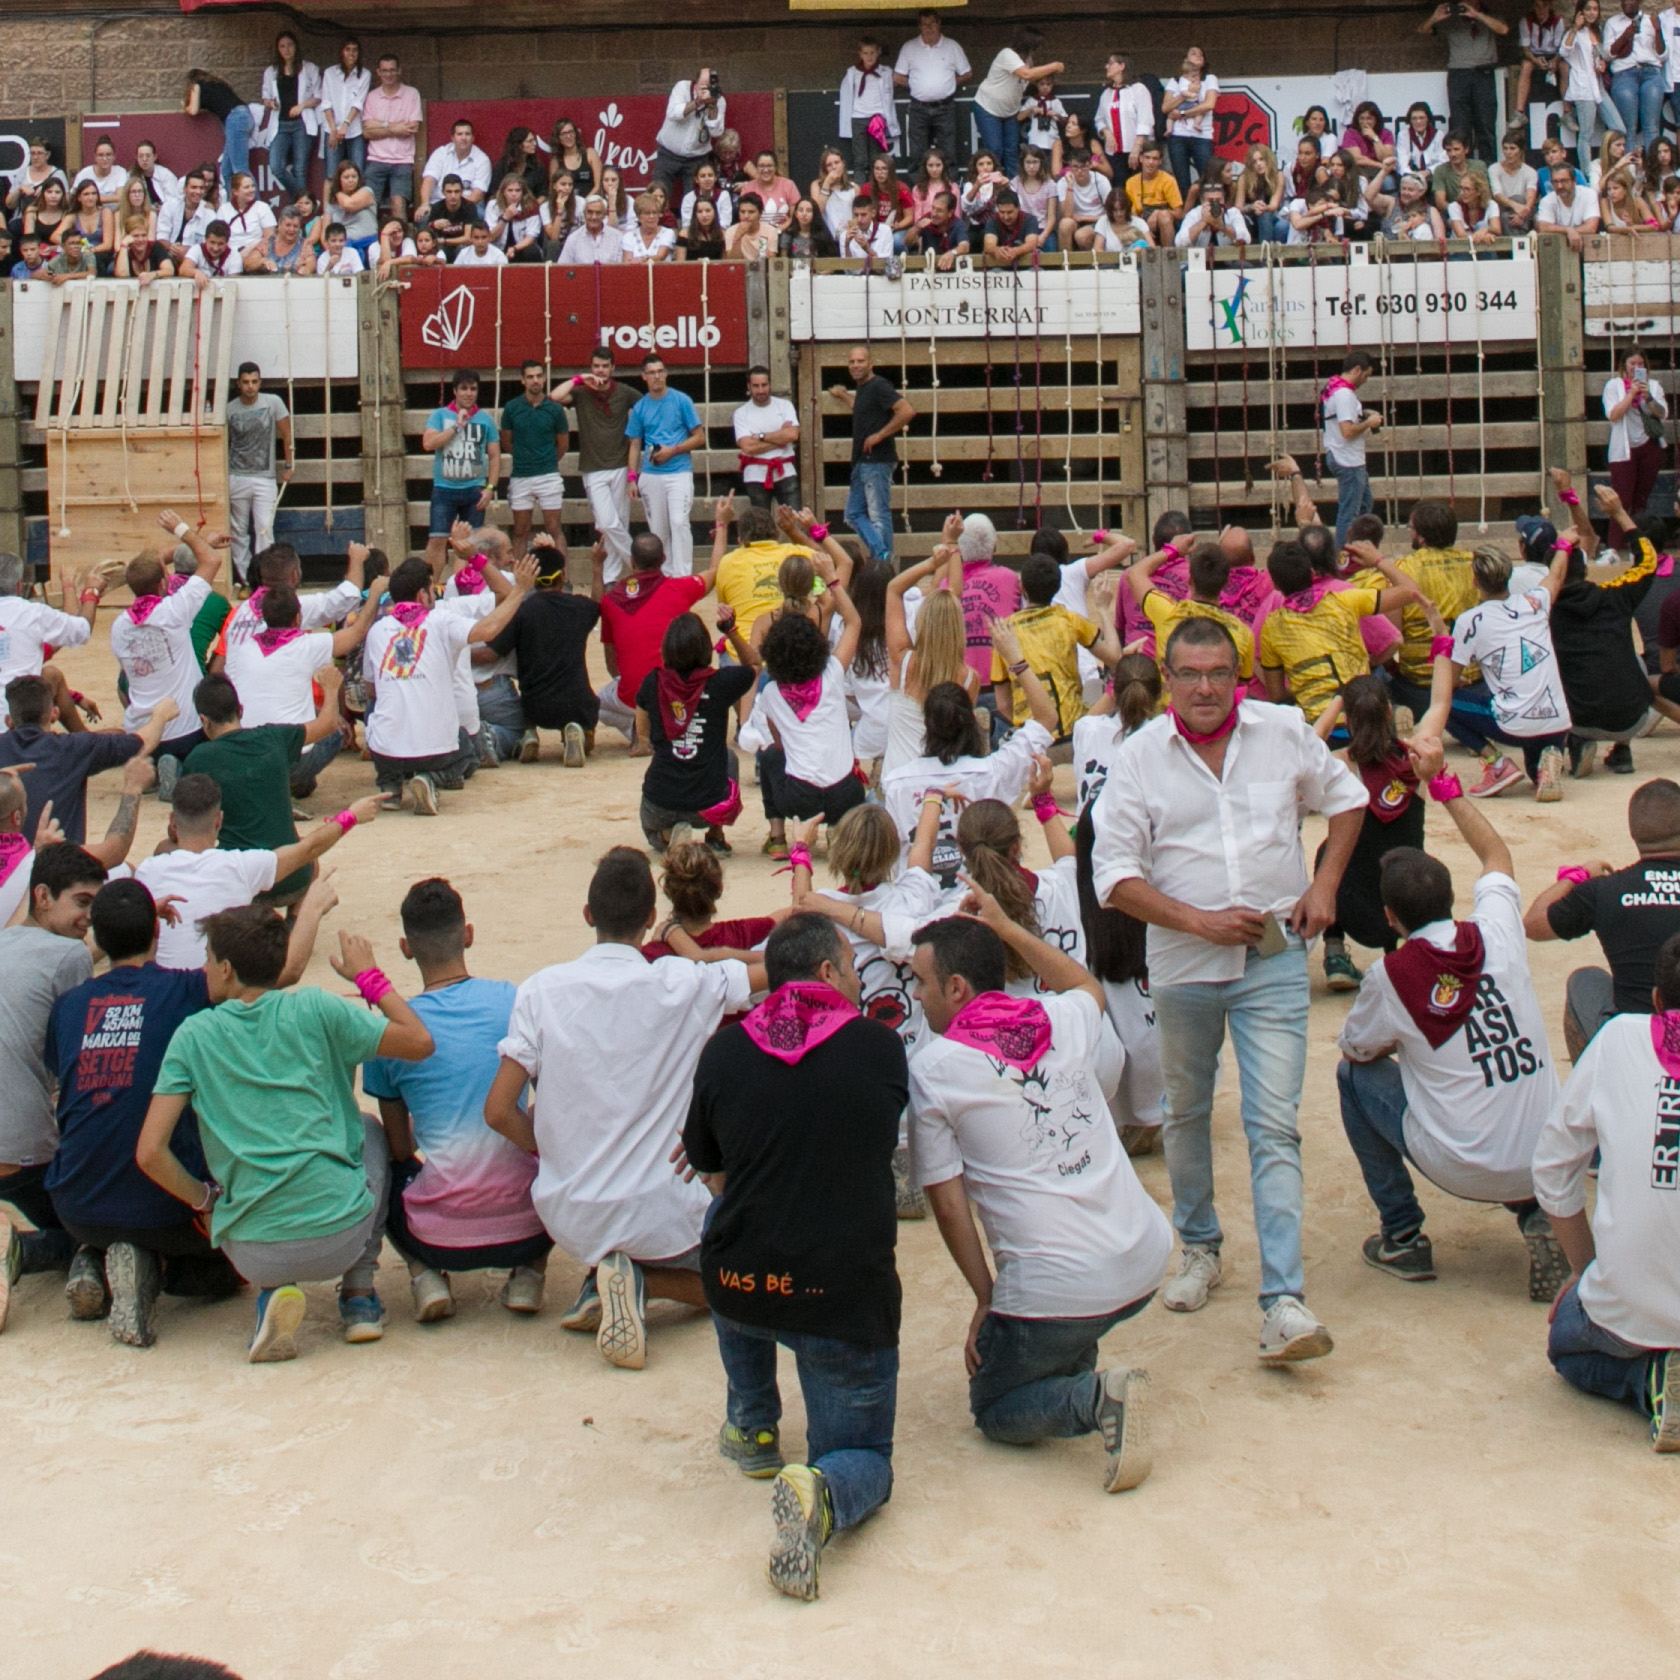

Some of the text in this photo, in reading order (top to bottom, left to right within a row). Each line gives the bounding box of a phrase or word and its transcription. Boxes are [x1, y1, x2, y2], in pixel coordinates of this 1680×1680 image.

[910, 274, 1024, 291] PASTISSERIA
[882, 306, 1049, 326] MONTSERRAT
[1325, 295, 1367, 317] Tel.
[1376, 293, 1417, 314] 630
[1425, 292, 1467, 313] 930
[600, 315, 721, 349] roselló
[105, 1003, 143, 1019] 52 KM
[81, 1031, 141, 1051] MARXA DEL
[1462, 1004, 1520, 1054] ASI
[77, 1047, 139, 1076] SETGE
[719, 1267, 756, 1293] VAS
[766, 1272, 794, 1296] BÉ
